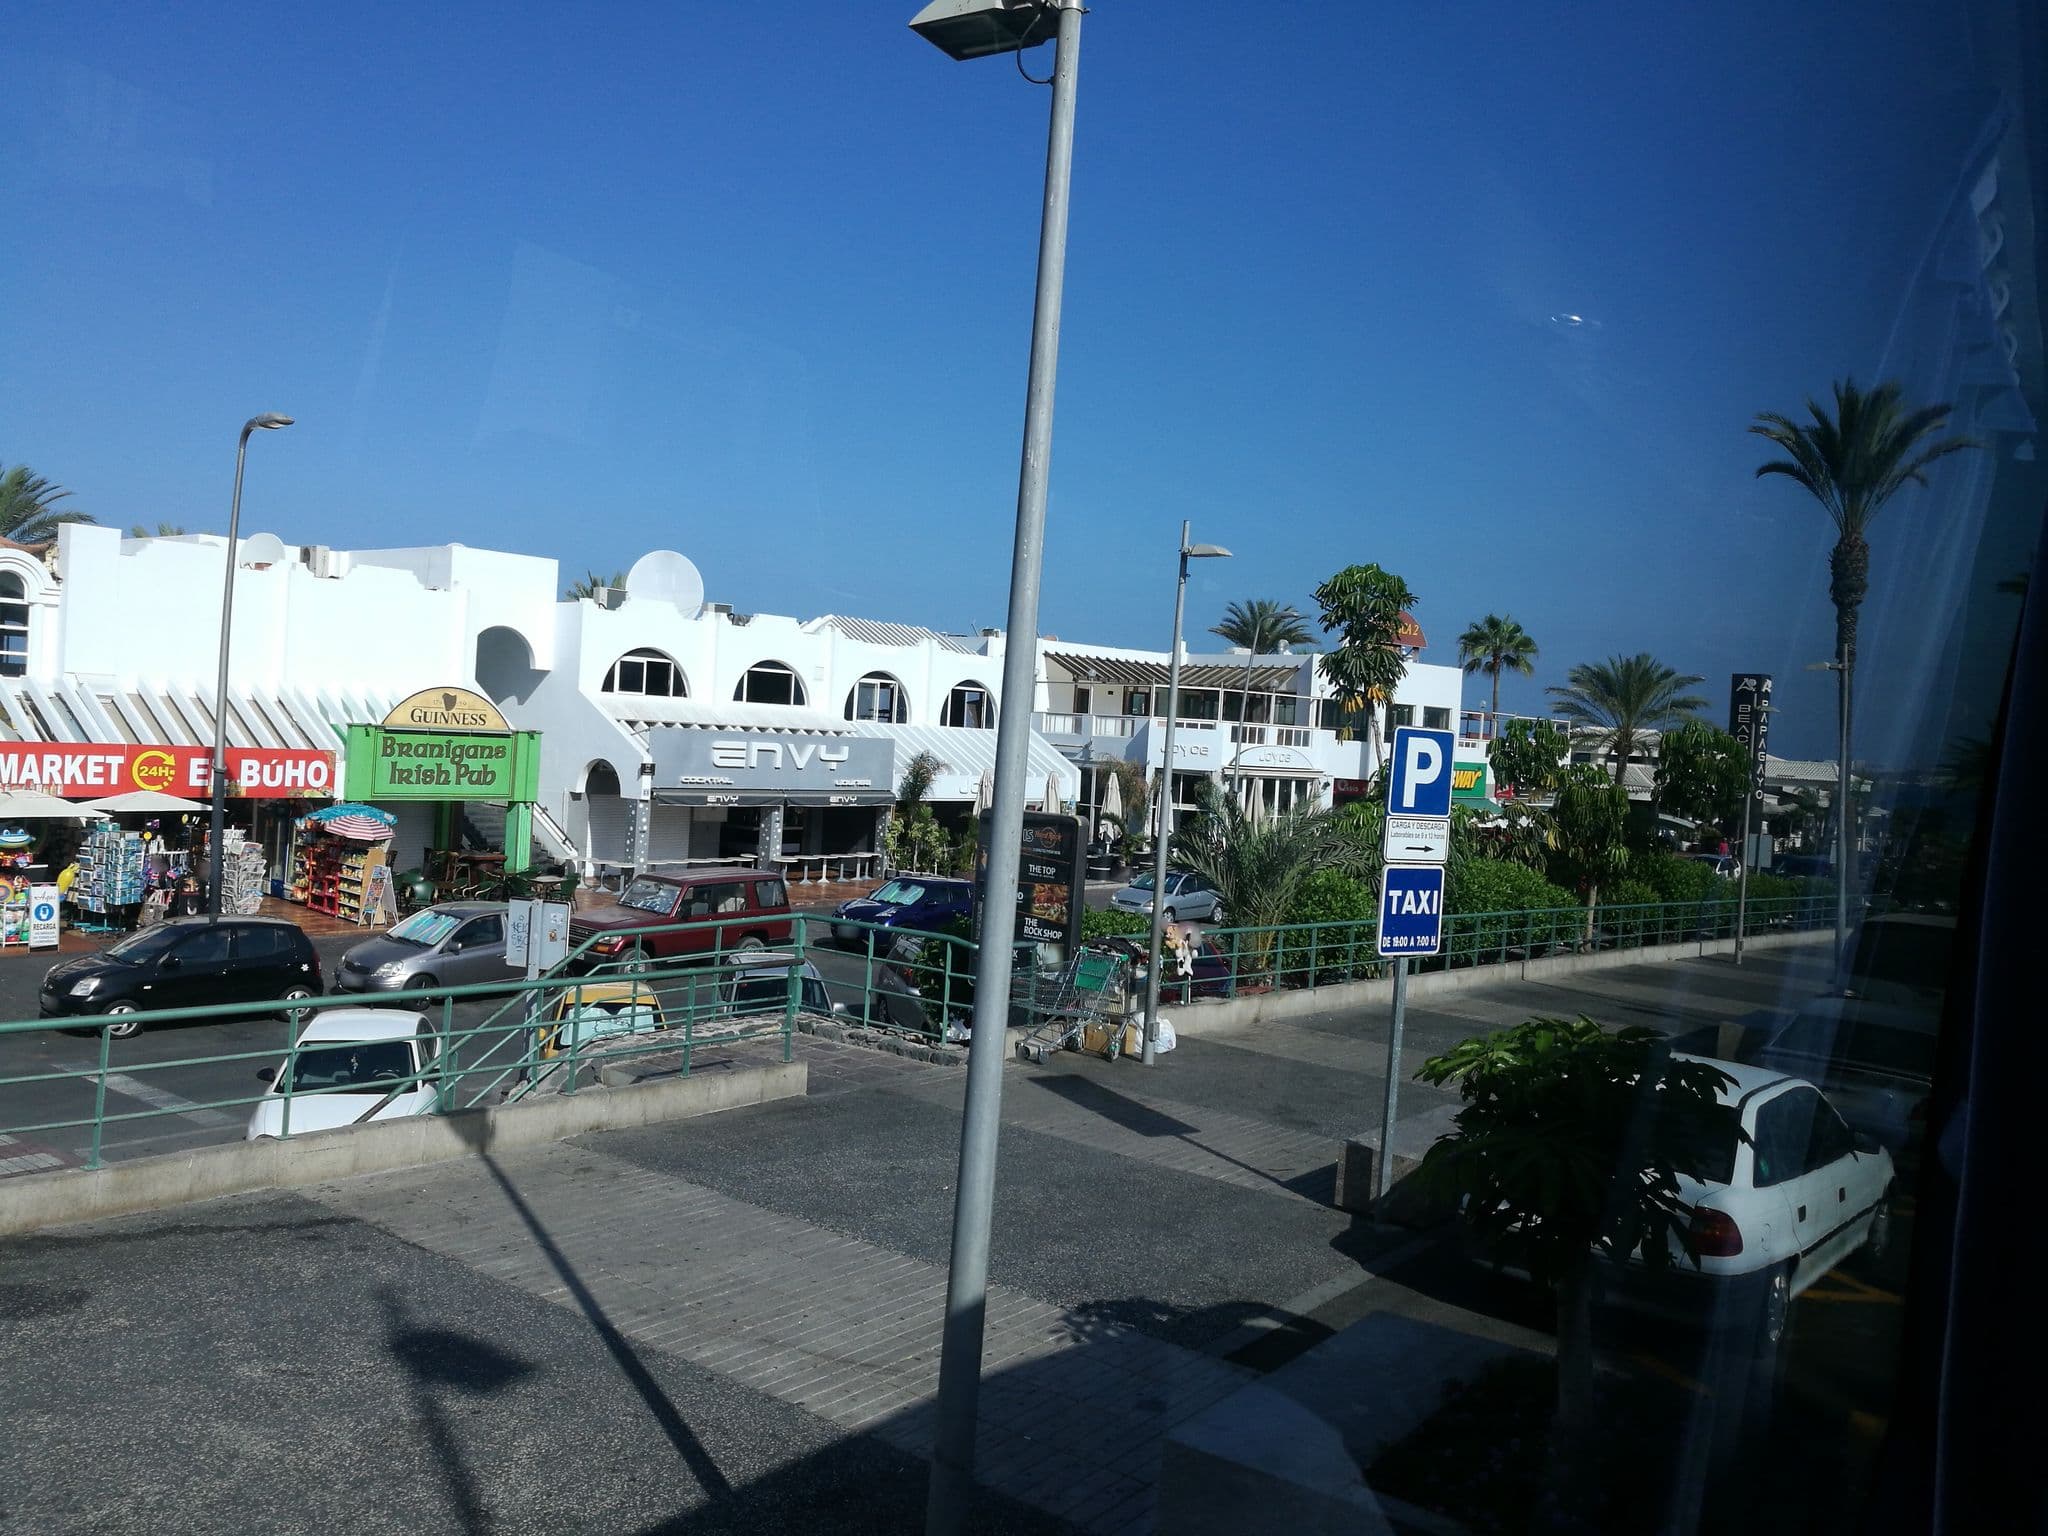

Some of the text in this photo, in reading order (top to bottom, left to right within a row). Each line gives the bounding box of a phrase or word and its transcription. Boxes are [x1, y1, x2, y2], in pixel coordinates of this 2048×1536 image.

[1413, 624, 1419, 635] 2
[410, 708, 487, 726] GUINNESS
[1736, 704, 1752, 750] BEAC
[381, 736, 507, 765] Branigans
[1258, 751, 1291, 763] JOYCE
[0, 753, 125, 785] MARKET
[139, 765, 169, 778] 24H
[240, 758, 328, 787] BÚHO
[389, 761, 496, 786] Irish Pub
[1402, 736, 1443, 808] P
[1391, 821, 1410, 829] CARGA
[1417, 822, 1445, 830] DESCARGA
[1029, 864, 1042, 874] THE
[1042, 866, 1057, 876] TOP
[1388, 890, 1439, 915] TAXI
[1025, 917, 1039, 927] THE
[1024, 925, 1045, 937] ROCK
[1043, 929, 1063, 940] SHOP
[1382, 936, 1391, 948] DE
[1409, 935, 1415, 947] A
